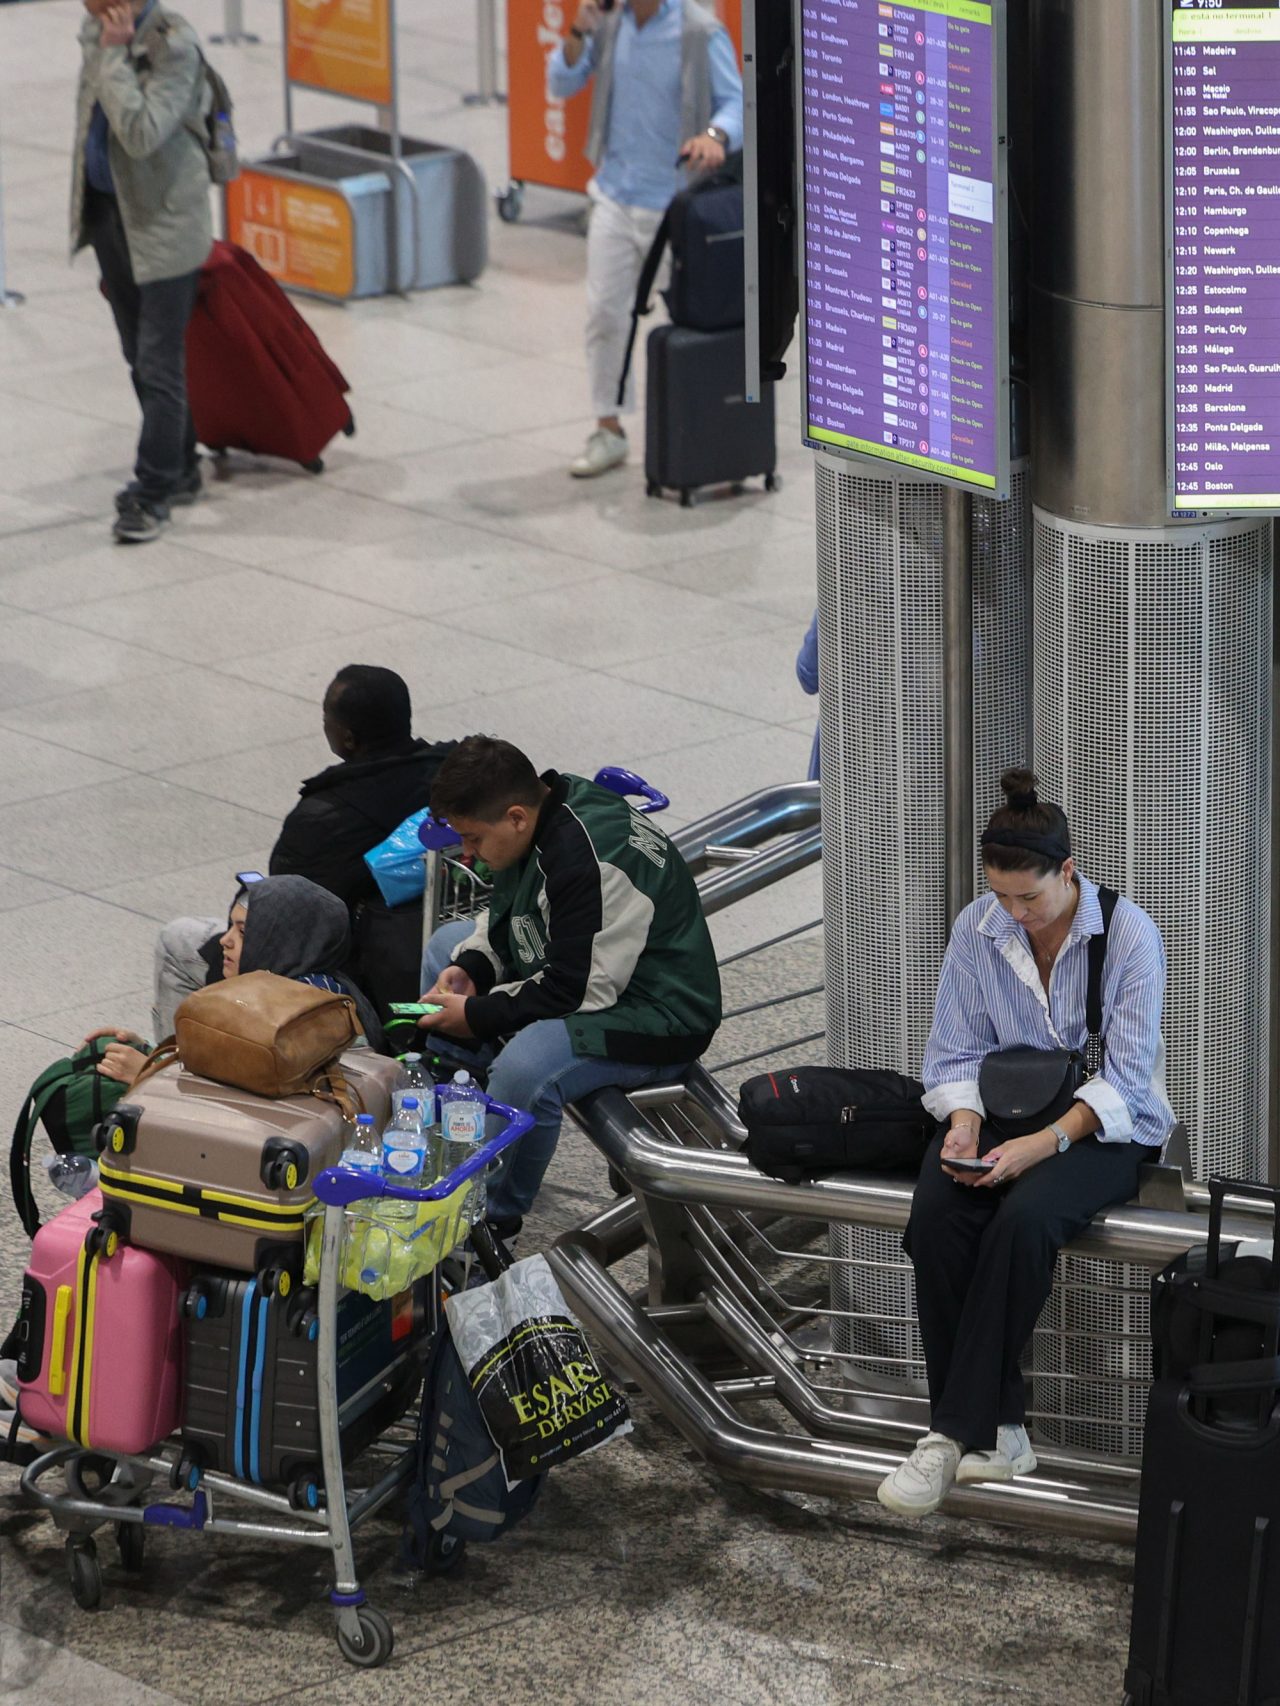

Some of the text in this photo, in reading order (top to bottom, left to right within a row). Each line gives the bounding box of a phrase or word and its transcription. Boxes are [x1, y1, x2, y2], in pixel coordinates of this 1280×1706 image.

[1226, 11, 1264, 20] terminal
[1174, 46, 1196, 56] 11:45
[1202, 46, 1236, 56] Madeira
[1174, 66, 1216, 76] 11:50 Sal
[1174, 86, 1196, 96] 11:55
[1174, 106, 1196, 116] 11:55
[1202, 106, 1218, 116] Sao
[1174, 126, 1196, 136] 12:00
[1202, 126, 1253, 137] Washington,
[1255, 125, 1280, 135] Dulles
[1175, 146, 1197, 156] 12:00
[1175, 166, 1197, 176] 12:05
[1203, 166, 1240, 176] Bruxelas
[1175, 186, 1197, 196] 12:10
[1245, 186, 1255, 195] de
[1175, 206, 1197, 216] 12:10
[1203, 206, 1247, 217] Hamburgo
[1175, 226, 1249, 237] 12:10 Copenhaga
[1176, 246, 1198, 256] 12:15
[1203, 246, 1236, 255] Newark
[1176, 266, 1198, 275] 12:20
[1203, 265, 1254, 276] Washington,
[1176, 286, 1198, 295] 12:25
[1203, 285, 1247, 295] Estocolmo
[1176, 305, 1198, 315] 12:25
[1204, 305, 1243, 316] Budapest
[1176, 325, 1198, 335] 12:25
[1230, 325, 1247, 335] Orly
[1176, 345, 1198, 354] 12:25
[1204, 344, 1234, 355] Málaga
[1176, 364, 1198, 374] 12:30
[1204, 364, 1219, 373] Sao
[1176, 383, 1233, 393] 12:30 Madrid
[1176, 404, 1198, 413] 12:35
[1204, 403, 1246, 412] Barcelona
[1176, 423, 1198, 432] 12:35
[1204, 422, 1228, 432] Ponta
[1230, 422, 1263, 433] Delgada
[1176, 443, 1198, 452] 12:40
[1231, 442, 1270, 453] Malpensa
[1176, 462, 1198, 471] 12:45
[1204, 461, 1223, 471] Oslo
[1176, 481, 1198, 491] 12:45
[1204, 481, 1233, 490] Boston
[536, 1383, 613, 1439] DERYASI
